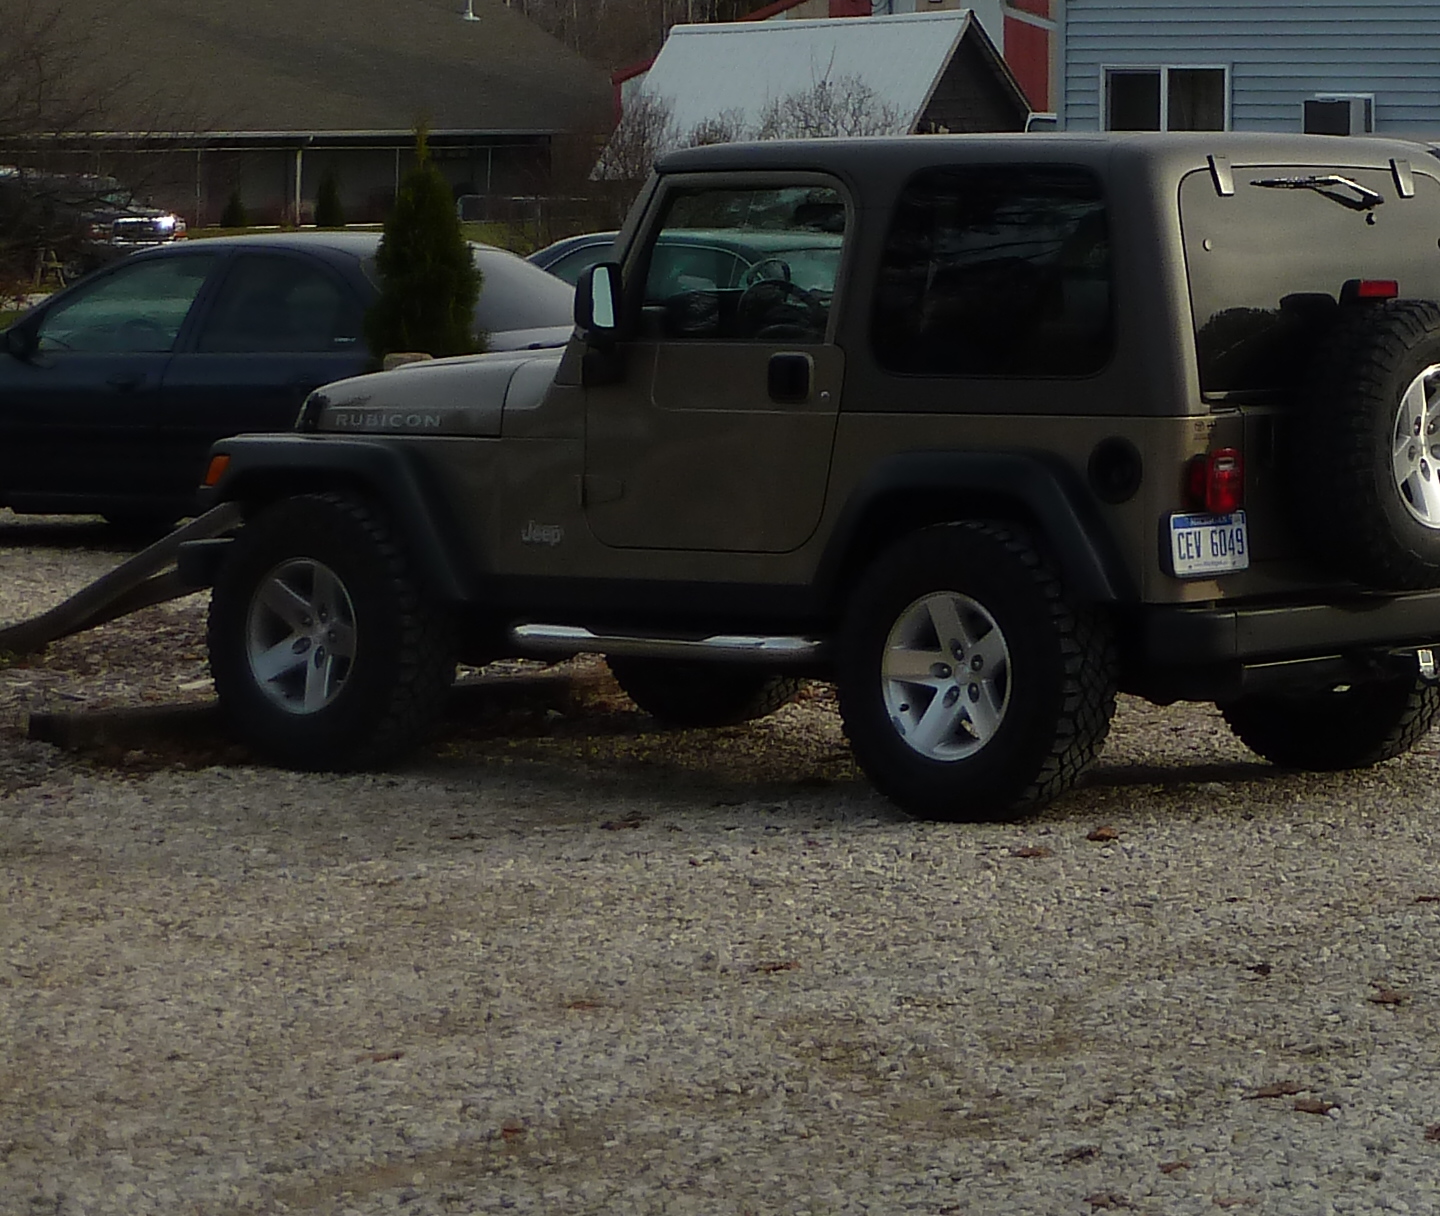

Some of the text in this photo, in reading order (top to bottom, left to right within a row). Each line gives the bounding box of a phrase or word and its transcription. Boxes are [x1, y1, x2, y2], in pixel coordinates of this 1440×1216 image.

[336, 413, 440, 427] RUBICON
[521, 520, 565, 546] Jeep
[1177, 528, 1245, 561] CEV 6049
